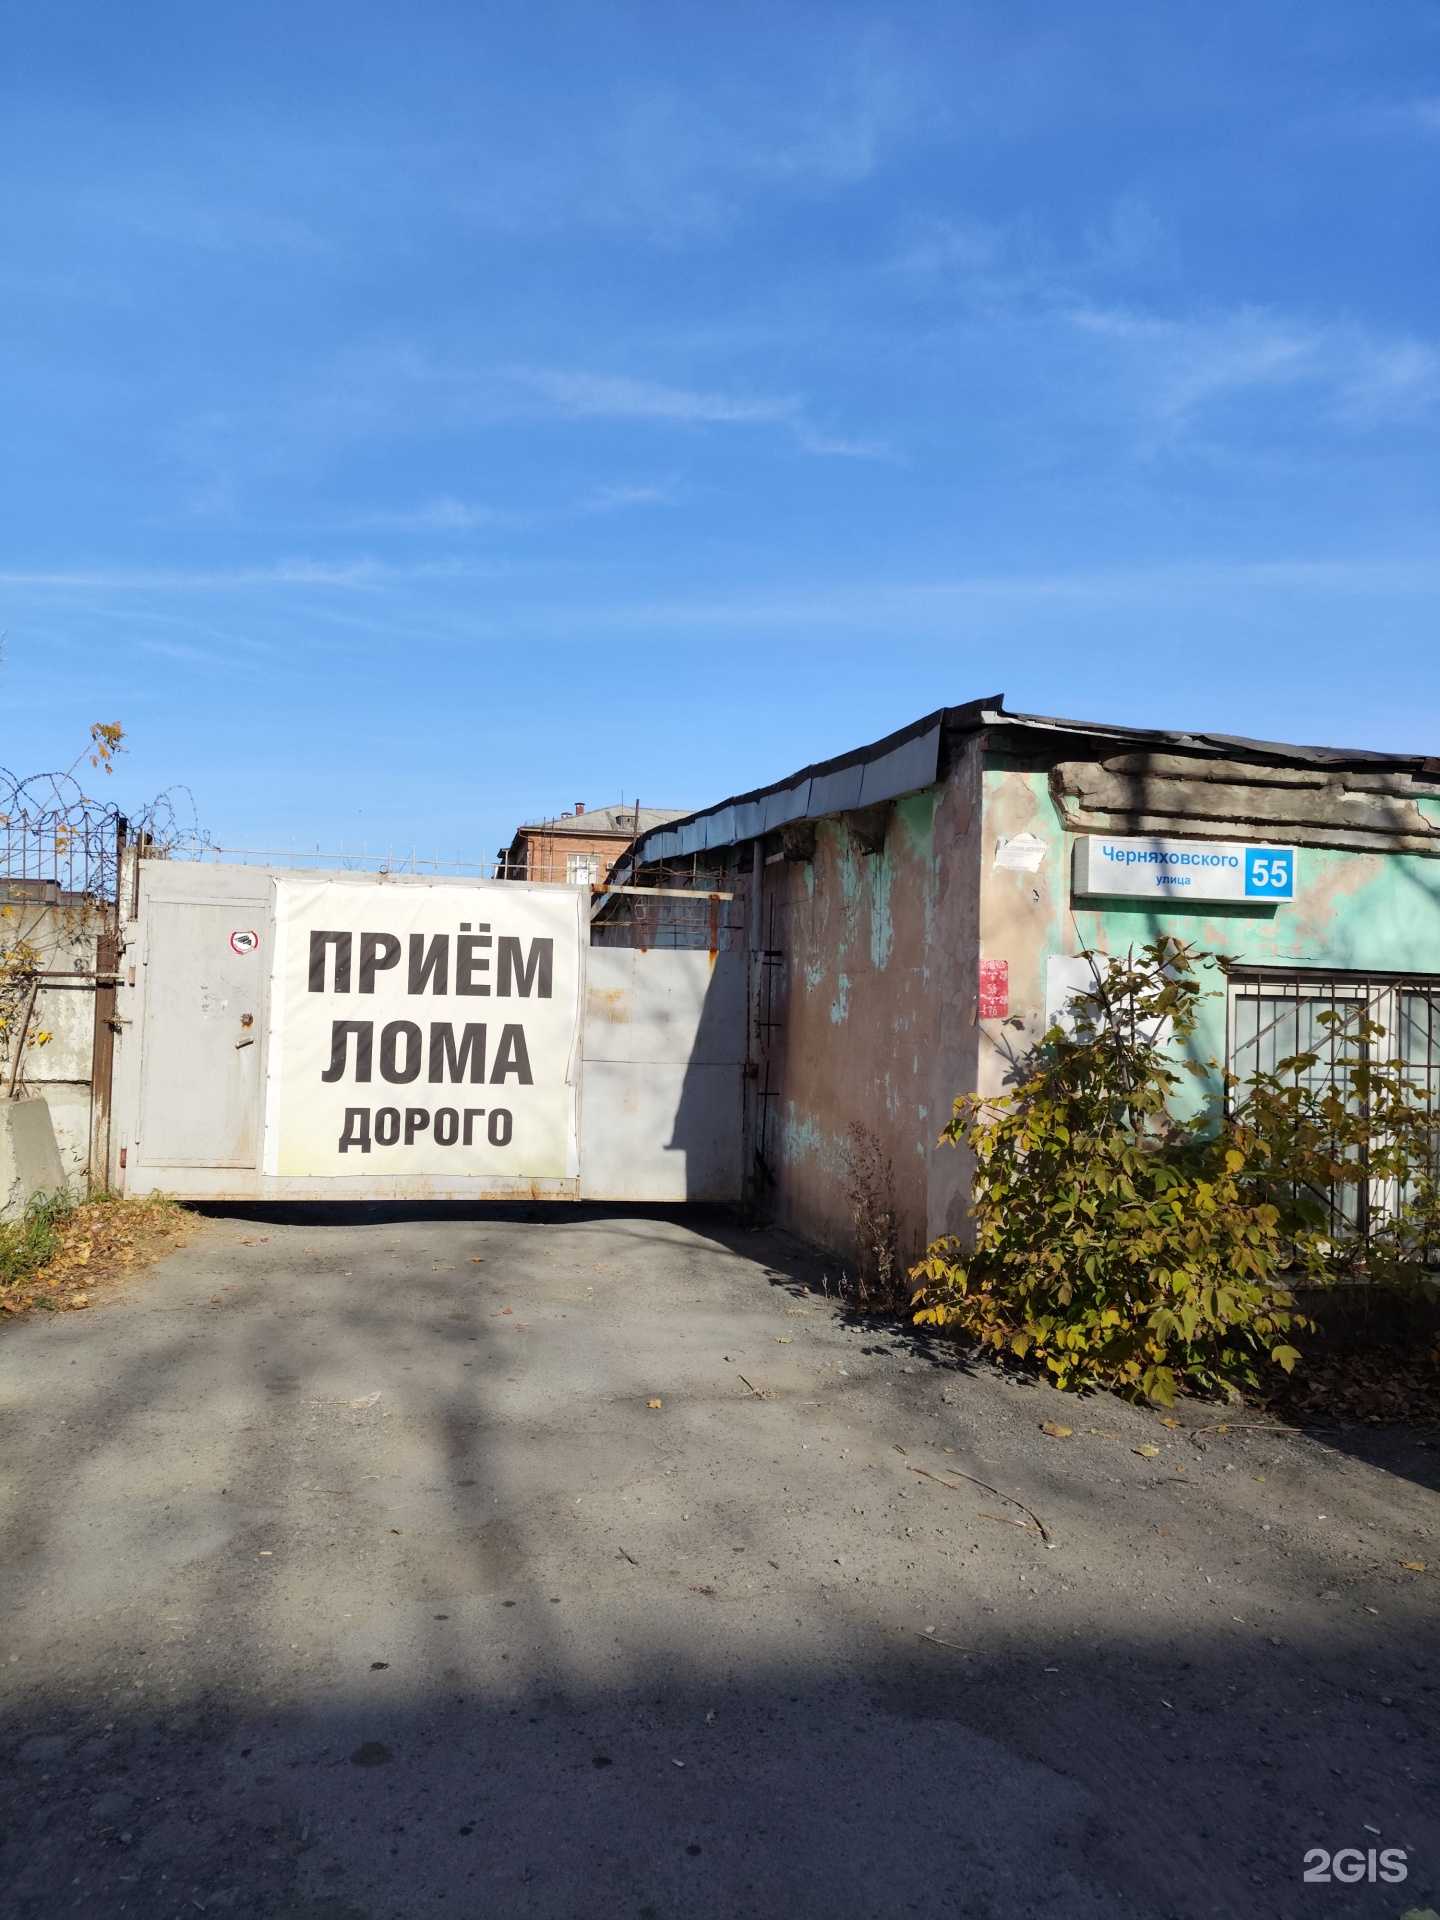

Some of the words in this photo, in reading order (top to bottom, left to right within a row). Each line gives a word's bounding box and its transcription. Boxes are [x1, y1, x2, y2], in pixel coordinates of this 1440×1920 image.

[1102, 845, 1239, 868] Черняховского
[1252, 859, 1288, 888] 55
[1156, 874, 1191, 886] улица
[308, 922, 553, 998] ПРИЁМ
[321, 1020, 534, 1085] ЛОМА
[338, 1107, 513, 1153] ДОРОГО
